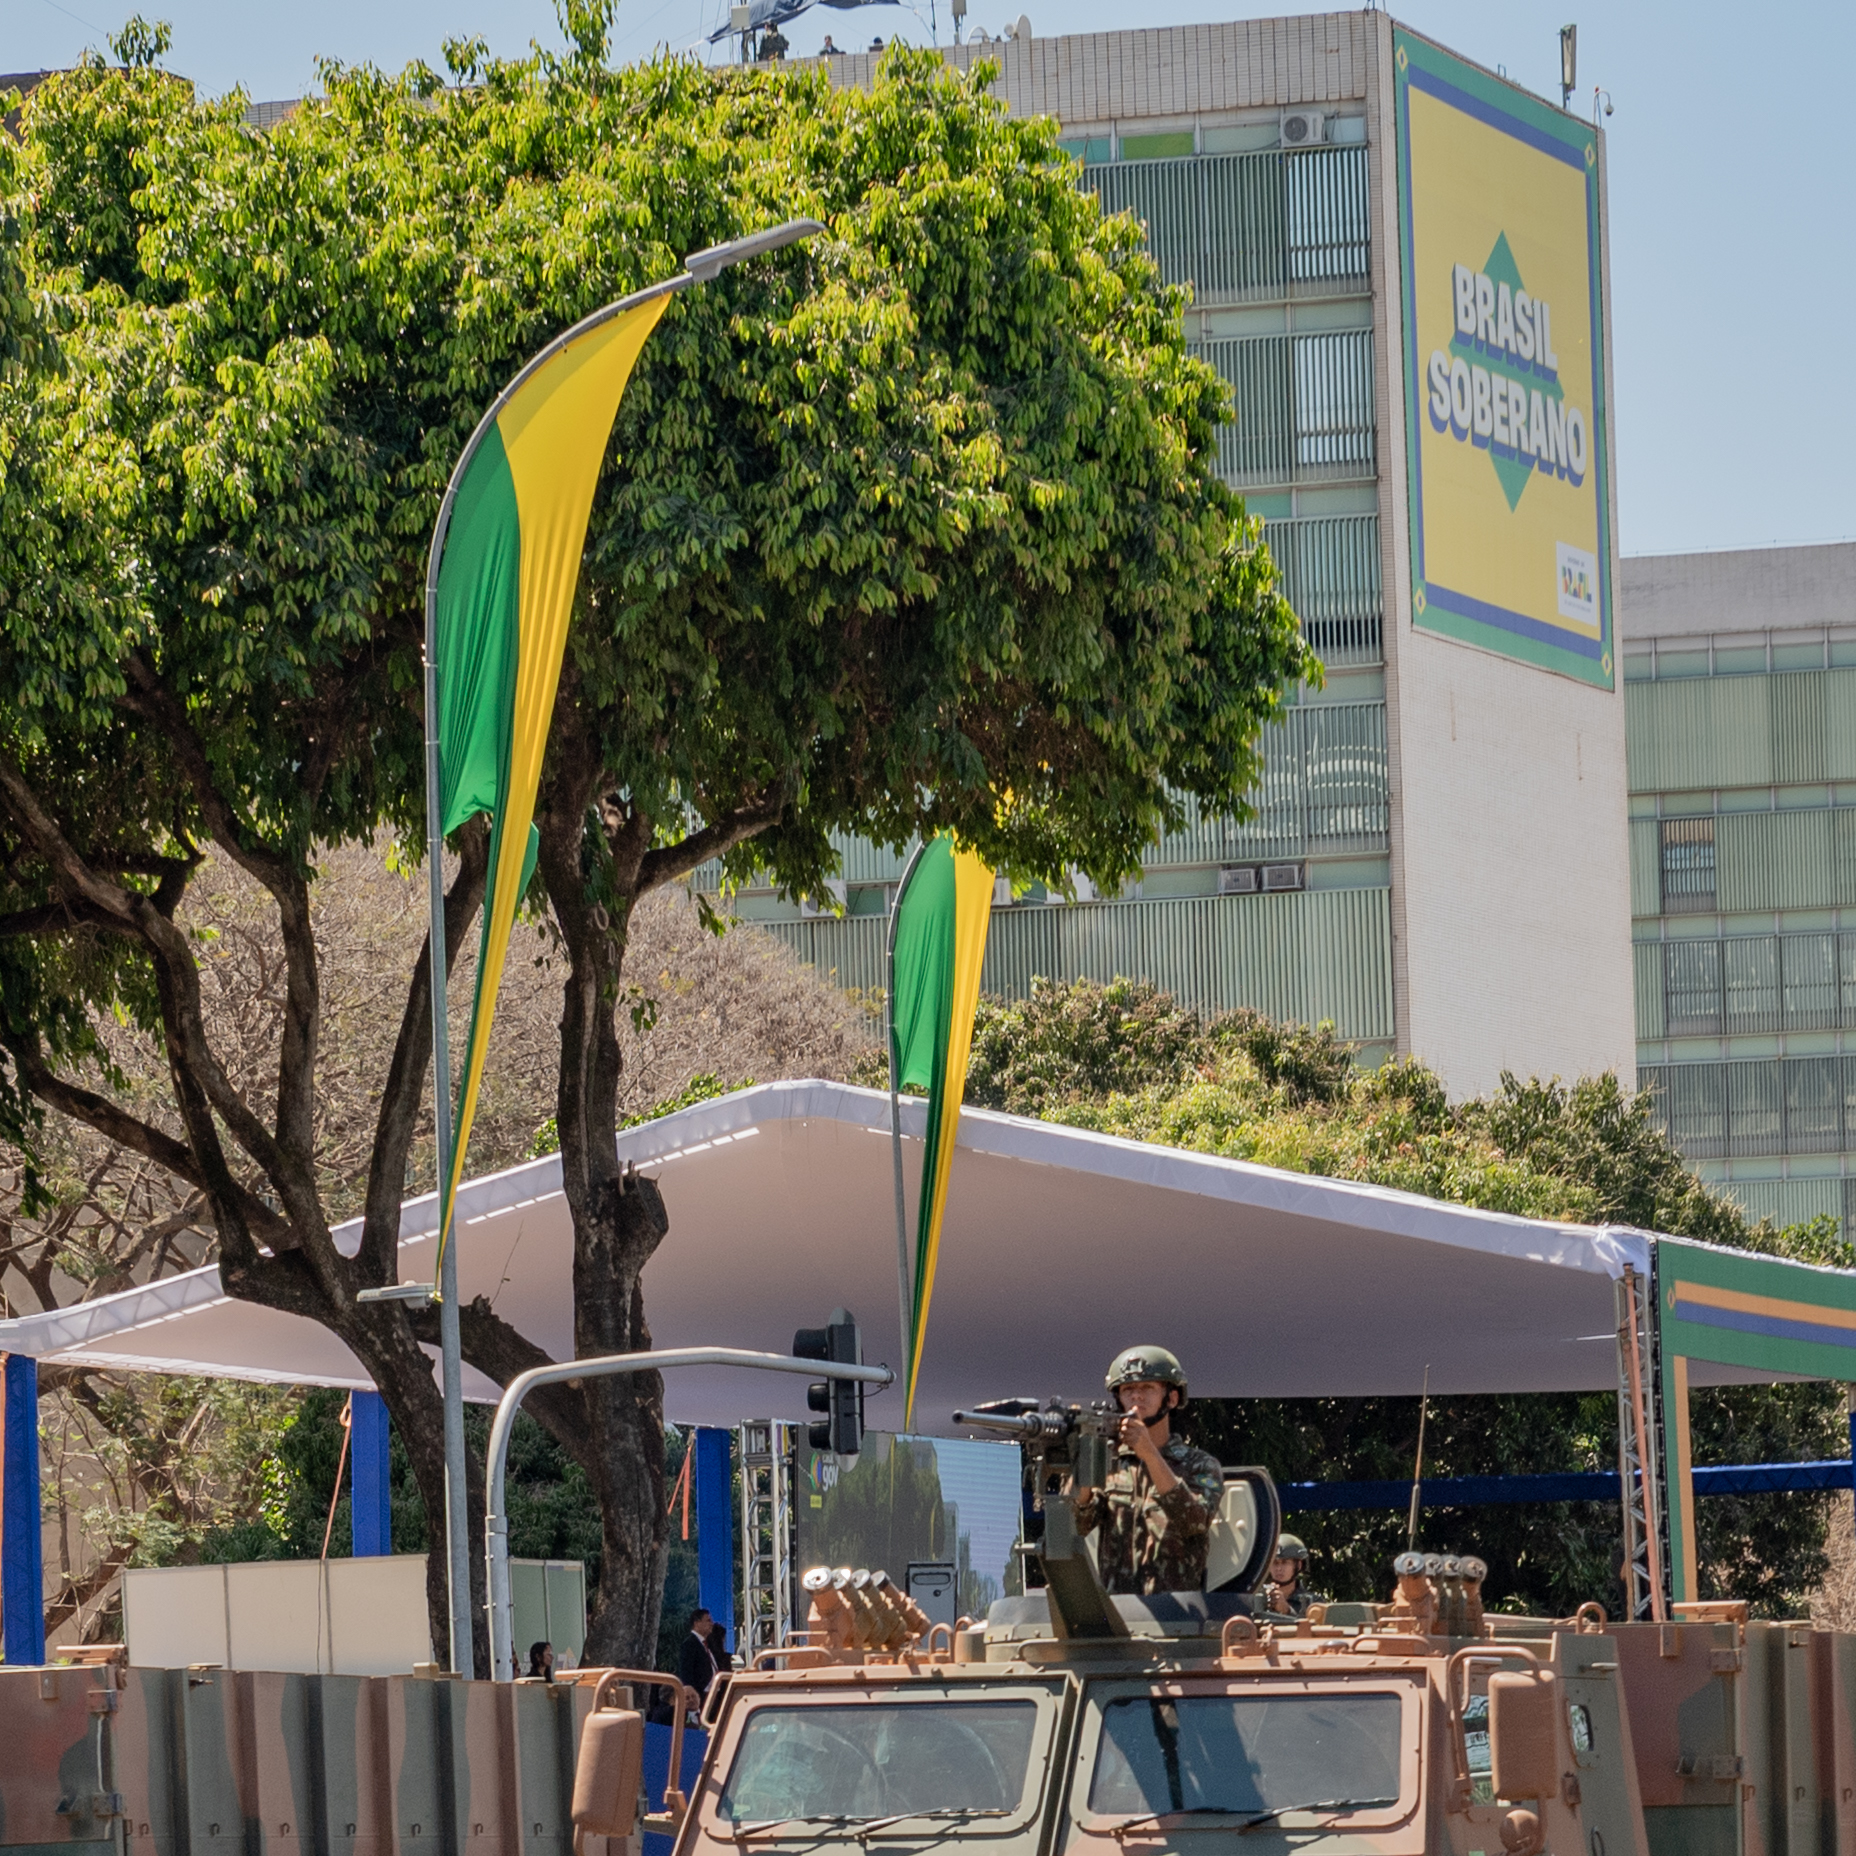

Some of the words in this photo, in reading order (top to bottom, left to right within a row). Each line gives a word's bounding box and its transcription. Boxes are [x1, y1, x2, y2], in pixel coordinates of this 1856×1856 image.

[1453, 262, 1557, 378] BRASIL
[1428, 350, 1586, 482] SOBERANO
[822, 1464, 839, 1492] gov
